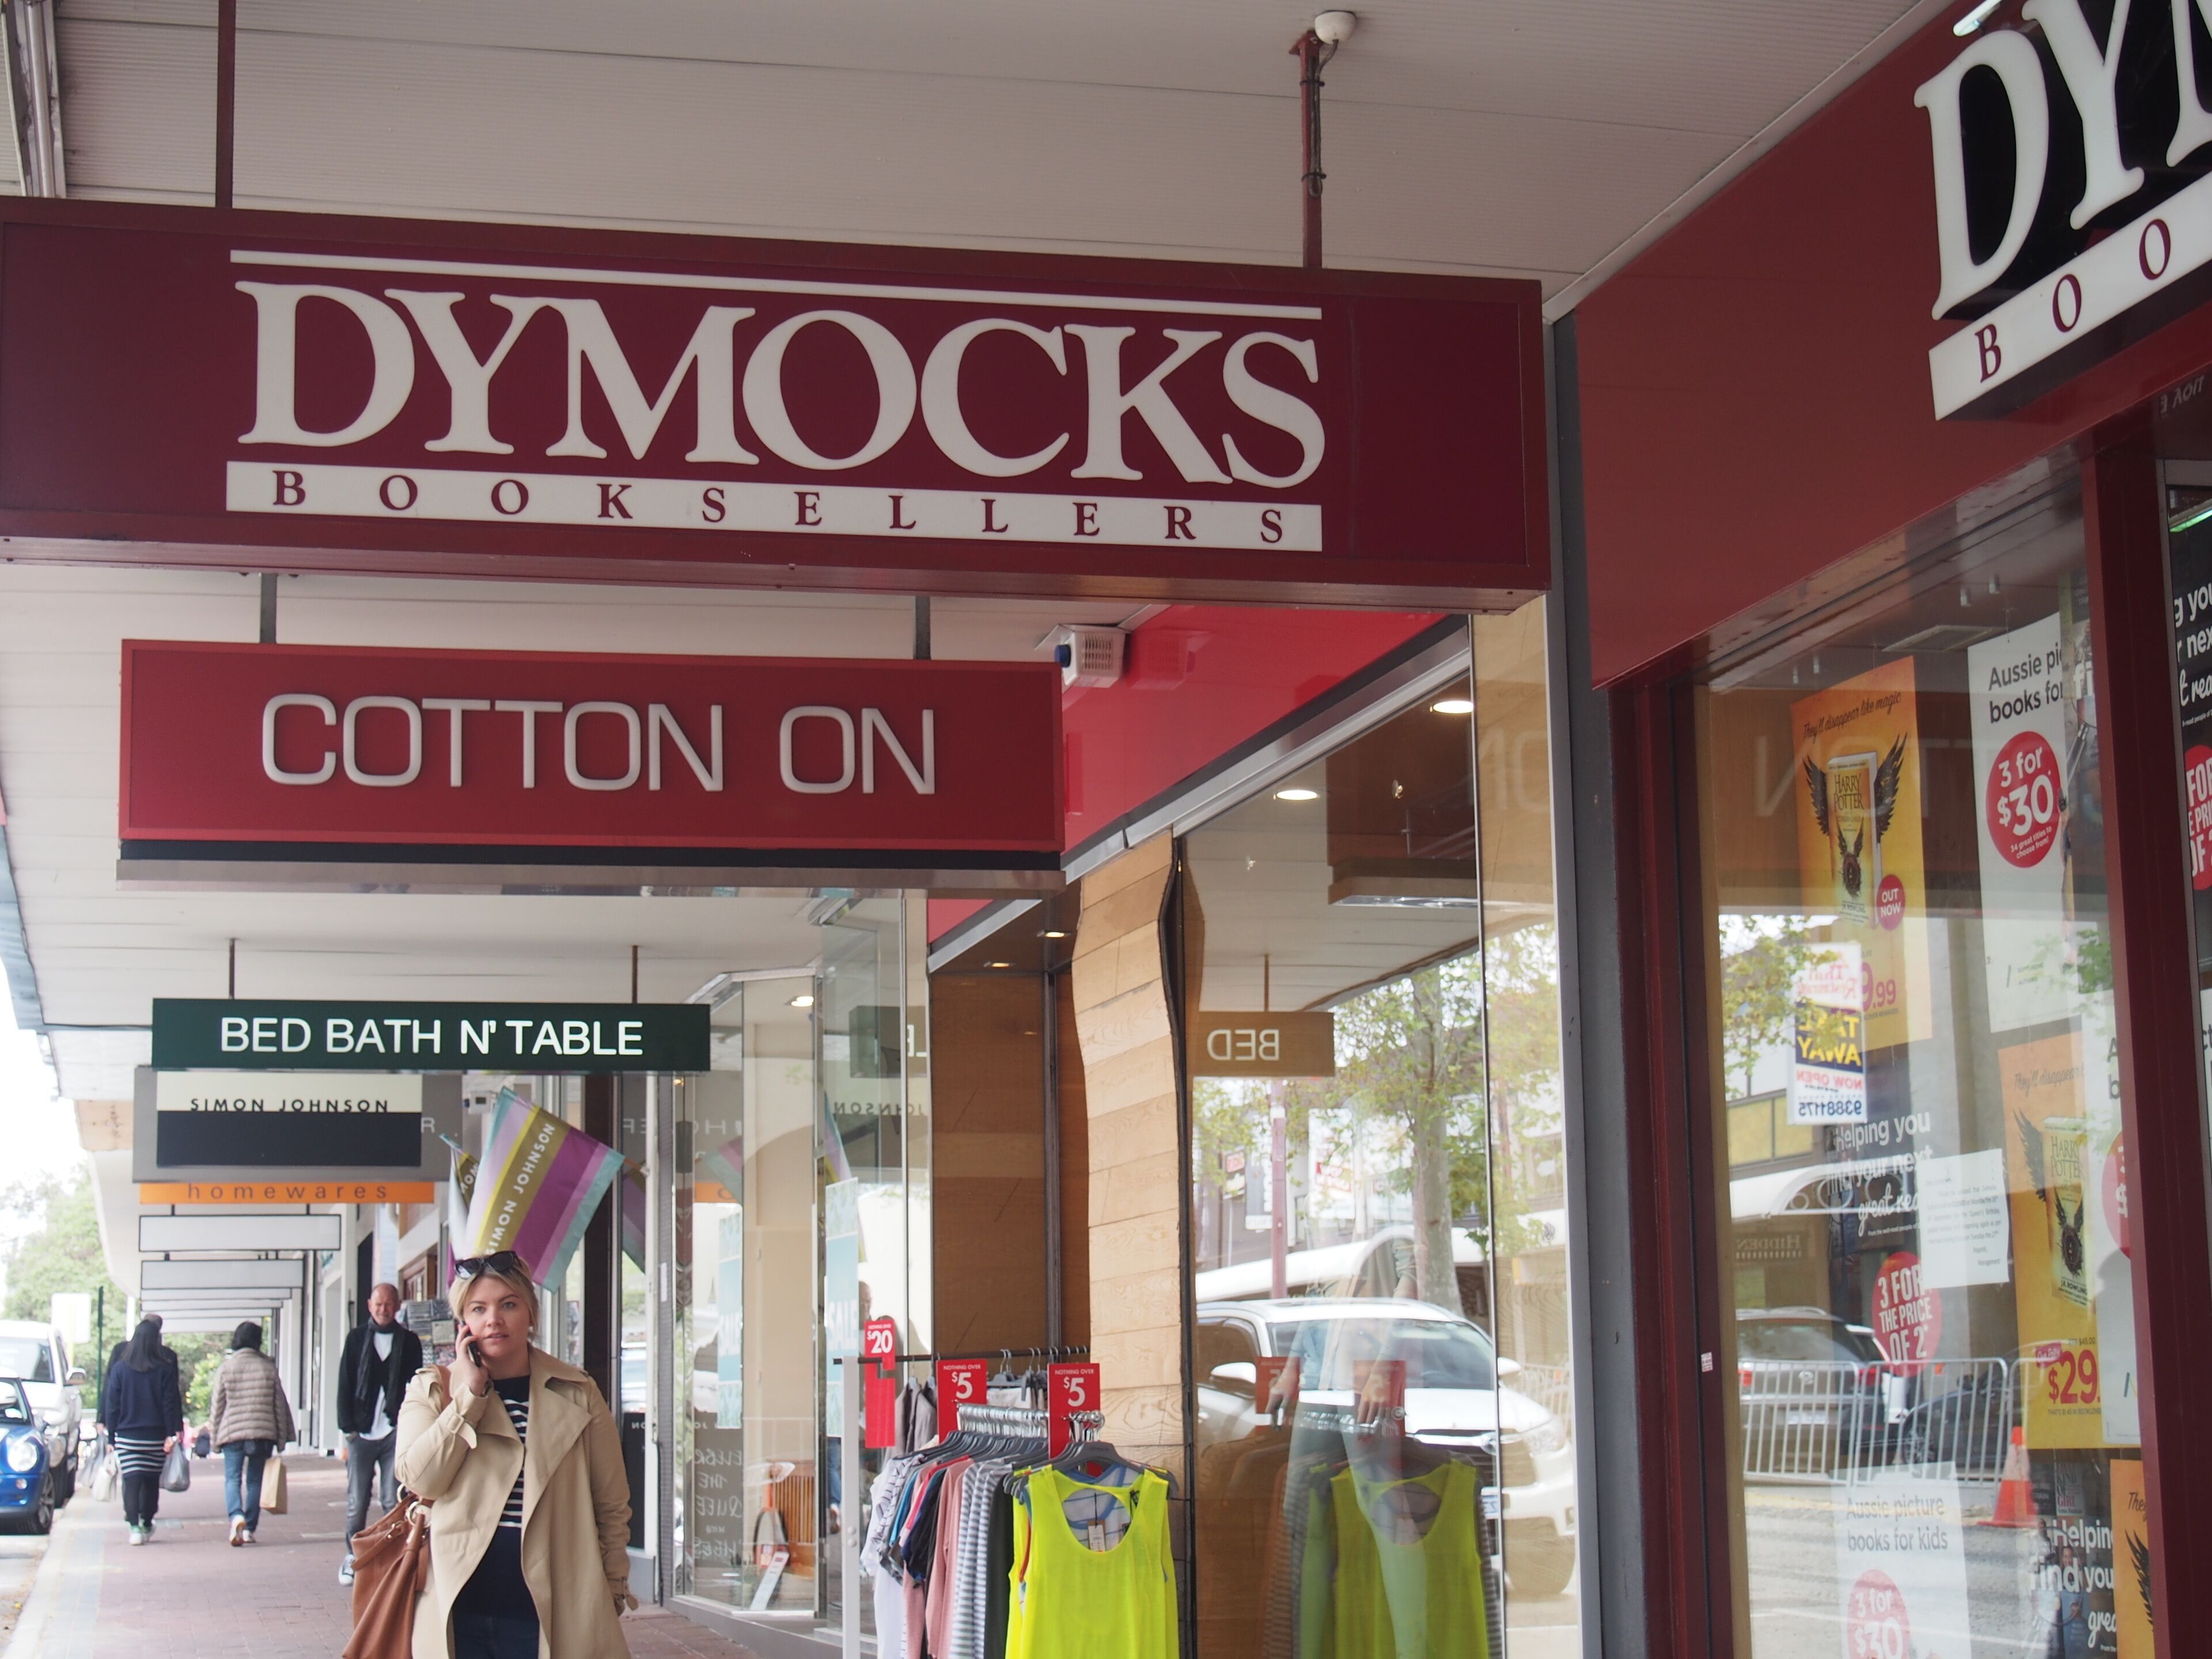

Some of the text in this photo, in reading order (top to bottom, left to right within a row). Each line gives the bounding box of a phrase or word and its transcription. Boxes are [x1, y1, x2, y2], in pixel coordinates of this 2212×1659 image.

[235, 281, 1324, 488] DYMOCKS
[272, 471, 1283, 543] BOOKSELLERS
[1988, 642, 2062, 691] Aussie pi
[1804, 691, 1900, 744] They'll disappear like magic
[1990, 690, 2041, 724] books
[262, 694, 935, 794] COTTON ON
[1998, 747, 2043, 787] 3 for
[1834, 773, 1862, 794] HARRY
[1834, 793, 1865, 812] POTTER
[2016, 845, 2035, 859] choose
[2018, 835, 2033, 850] great
[2033, 830, 2046, 842] titles
[1881, 888, 1899, 903] OUT
[1881, 902, 1900, 918] NOW
[221, 1017, 644, 1055] BED BATH N' TABLE
[191, 1099, 388, 1113] SIMON JOHNSON
[1894, 1112, 1930, 1143] you
[513, 1123, 555, 1194] JOHNSON
[2051, 1156, 2085, 1179] POTTER
[188, 1183, 387, 1199] homewares
[1858, 1182, 1894, 1237] great
[1878, 1276, 1889, 1309] 3
[1879, 1297, 1933, 1334] THE PRICE
[867, 1330, 893, 1354] $20
[1889, 1329, 1910, 1365] OF
[951, 1371, 973, 1399] $5
[1063, 1376, 1086, 1407] $5
[1846, 1494, 1945, 1521] Aussie picture
[1847, 1525, 1948, 1552] books for kids
[2053, 1518, 2113, 1554] Helpin
[1855, 1588, 1893, 1618] 3 for
